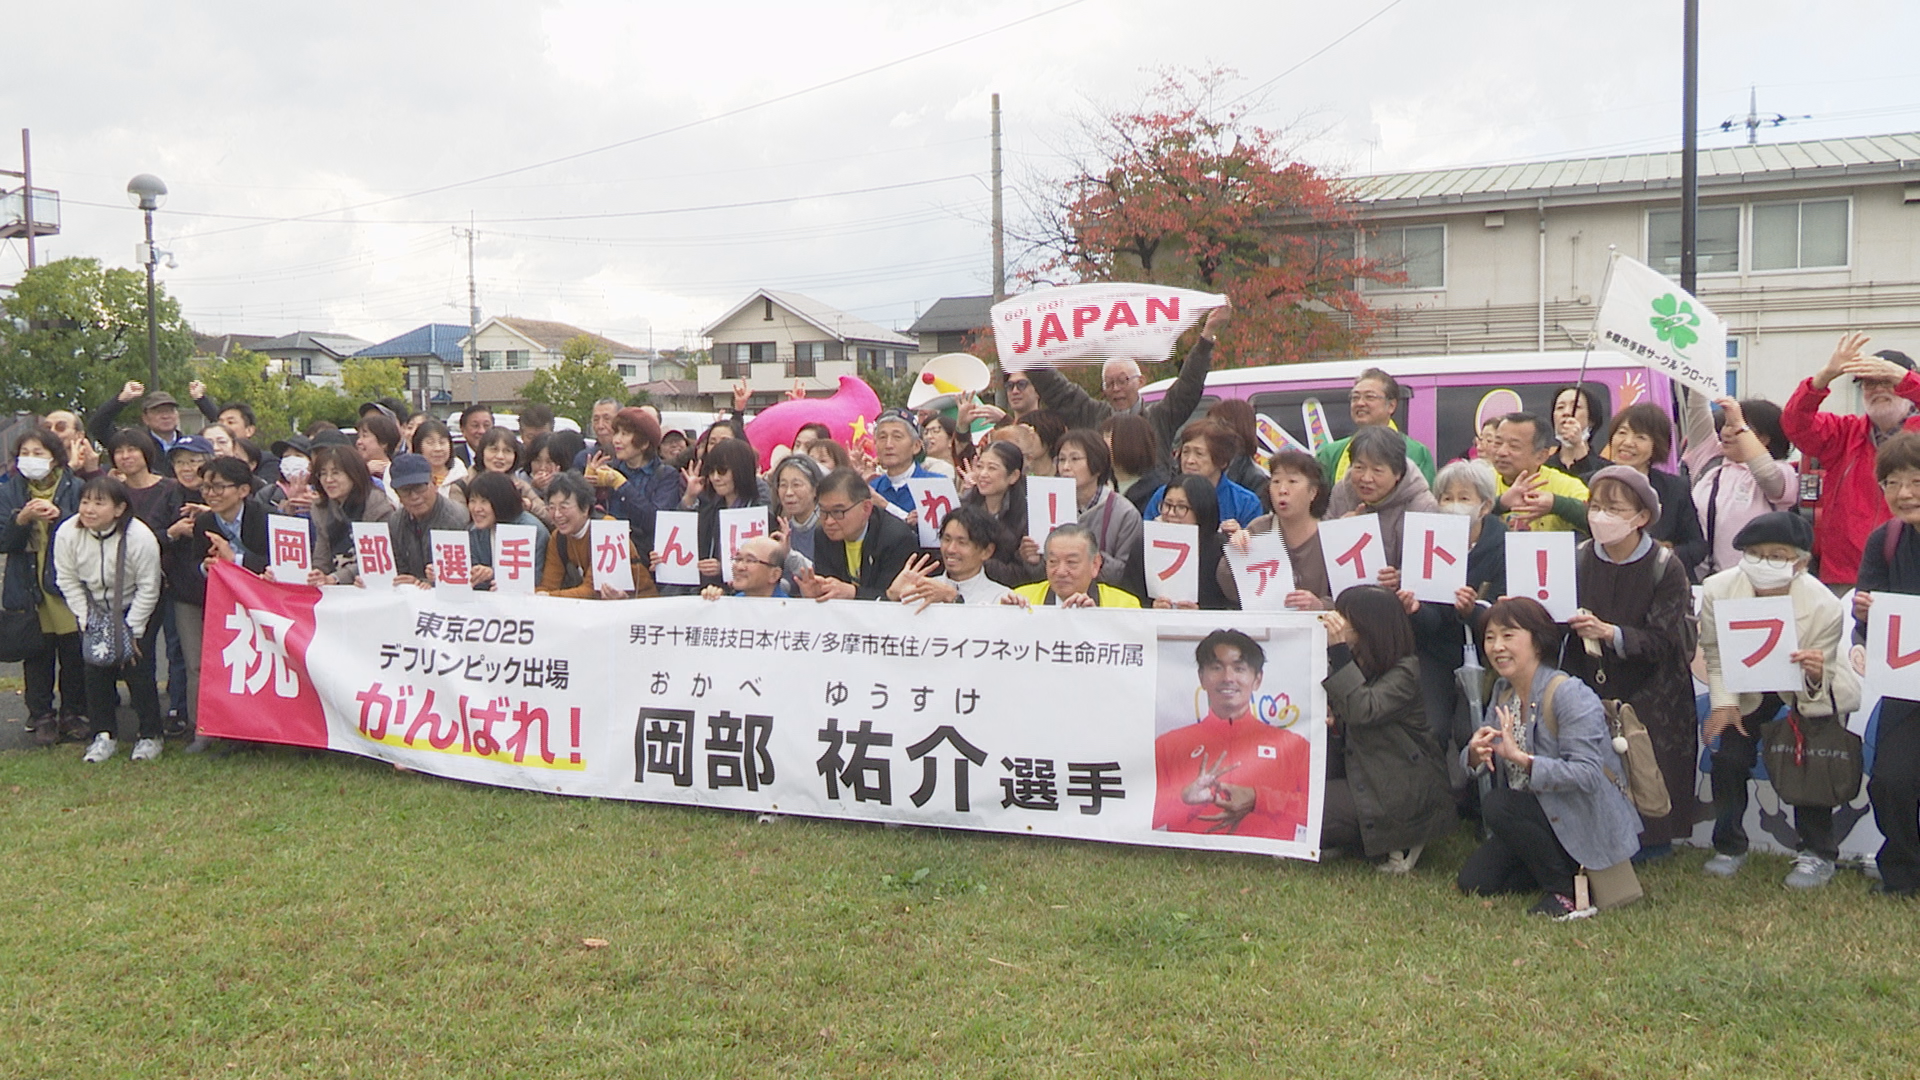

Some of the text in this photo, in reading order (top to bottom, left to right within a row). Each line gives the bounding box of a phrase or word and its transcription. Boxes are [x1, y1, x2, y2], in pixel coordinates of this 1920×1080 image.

[1011, 296, 1180, 354] JAPAN
[273, 527, 308, 570] 岡
[358, 534, 394, 576] 部
[435, 542, 469, 586] 選
[498, 538, 533, 581] 手
[596, 533, 628, 574] が
[661, 525, 695, 567] ん
[1151, 539, 1192, 581] フ
[1335, 531, 1374, 579] イ
[1423, 529, 1457, 580] ト
[414, 609, 535, 646] 東京2025
[1728, 617, 1785, 668] フ
[222, 601, 300, 700] 祝
[379, 641, 571, 691] デフリンピック出場
[355, 681, 583, 766] がんばれ!
